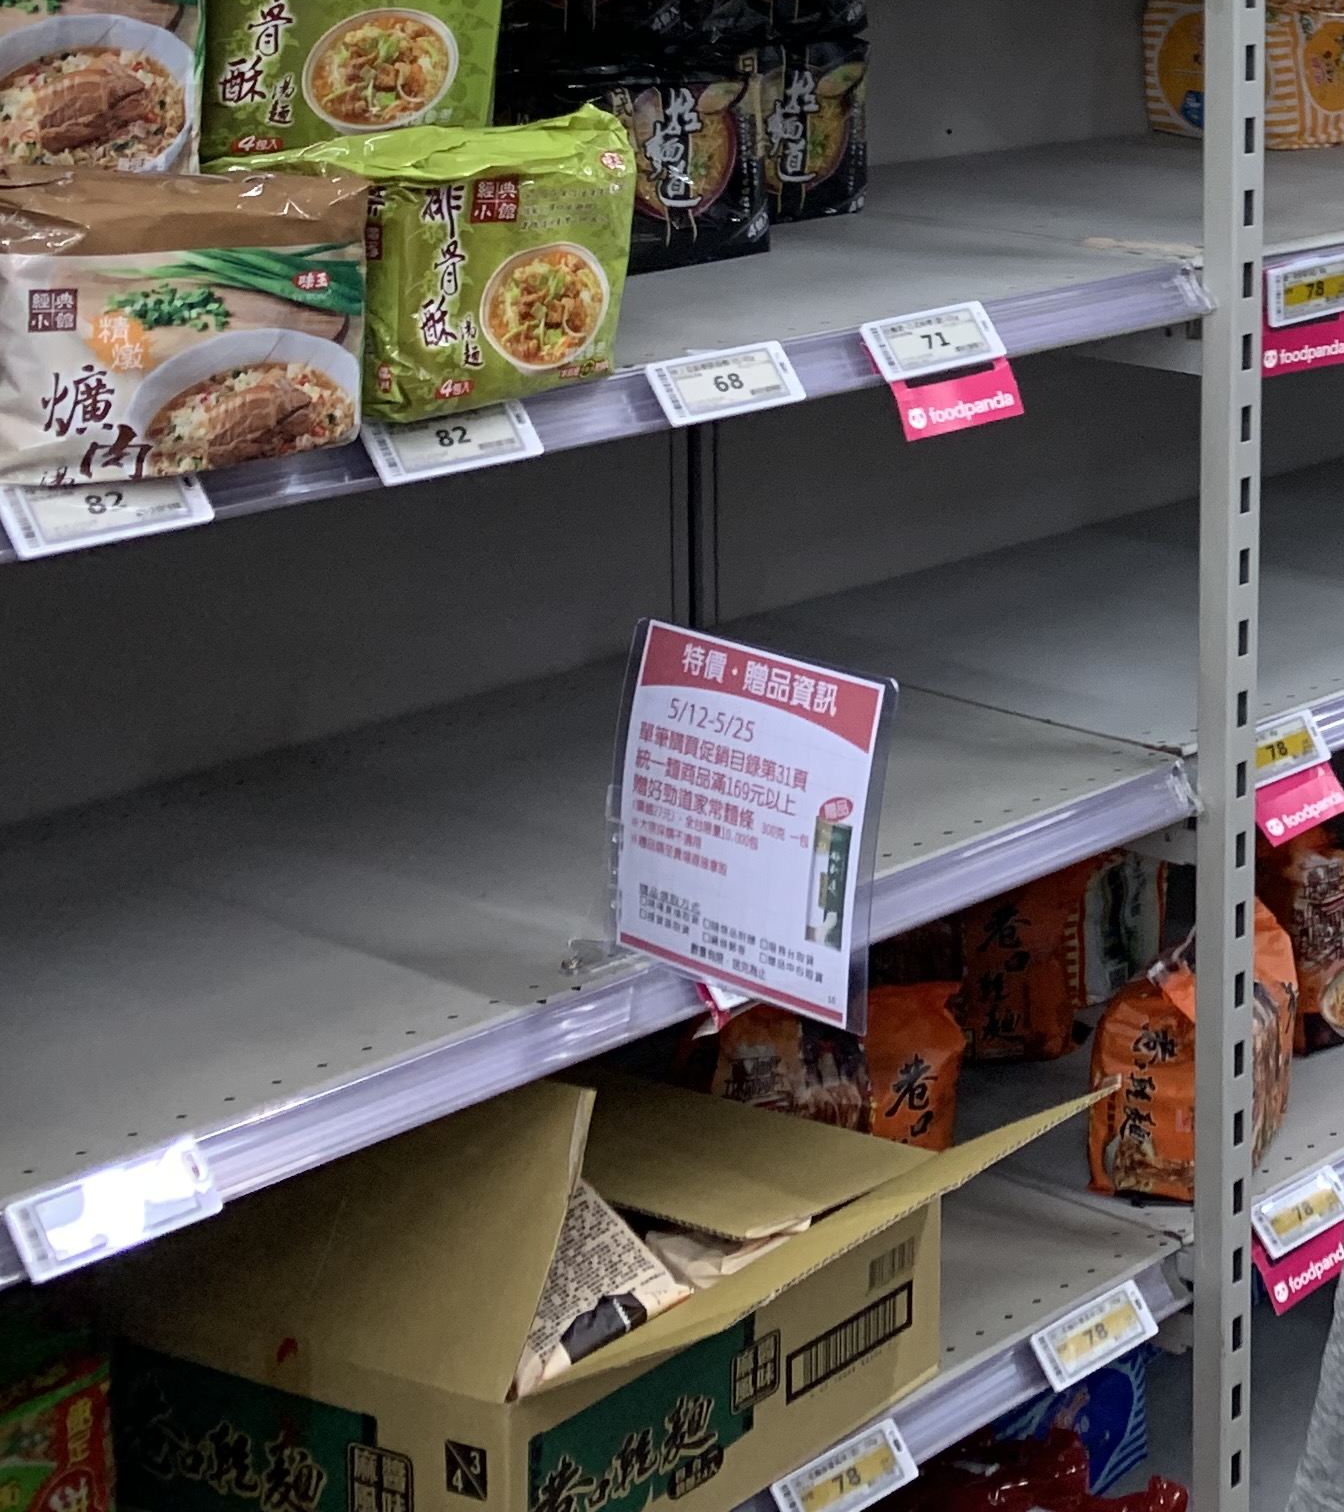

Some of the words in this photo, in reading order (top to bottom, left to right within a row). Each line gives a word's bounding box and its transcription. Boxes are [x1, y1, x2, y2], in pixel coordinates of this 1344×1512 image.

[646, 87, 703, 209] 拉麵道
[477, 179, 519, 199] 經典
[473, 202, 518, 220] 小館
[420, 183, 466, 348] 排骨酥
[296, 272, 330, 290] 味王
[1304, 280, 1325, 299] 78
[32, 291, 76, 311] 經典
[30, 310, 75, 329] 小館
[98, 316, 145, 371] 精燉
[920, 331, 952, 351] 71
[713, 372, 745, 394] 68
[928, 392, 1015, 426] foodpanda
[42, 364, 154, 482] 爌肉
[436, 424, 471, 448] 82
[84, 489, 128, 516] 82
[667, 697, 755, 742] 5/12-5/25
[1265, 740, 1289, 760] 78
[1282, 790, 1344, 829] foodpanda
[1082, 1321, 1110, 1349] 78
[469, 1451, 482, 1475] 3
[451, 1468, 463, 1493] 4
[831, 1467, 863, 1494] 78
